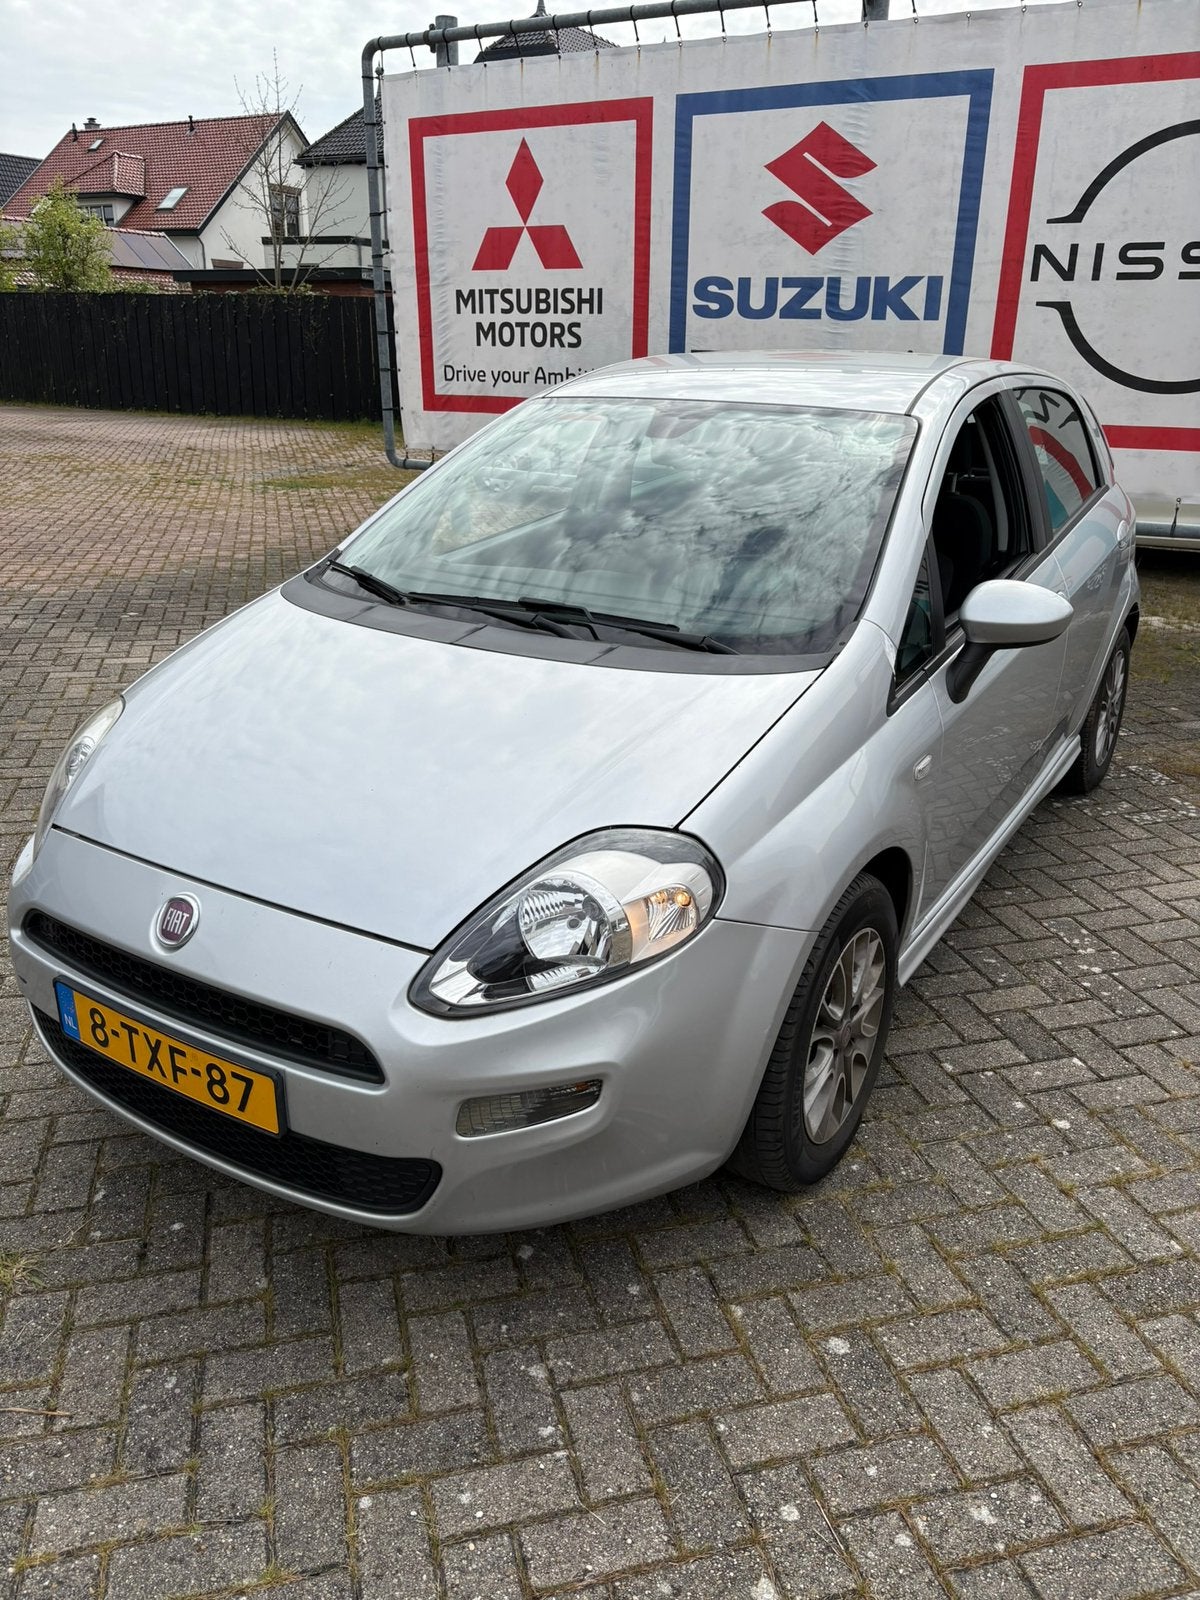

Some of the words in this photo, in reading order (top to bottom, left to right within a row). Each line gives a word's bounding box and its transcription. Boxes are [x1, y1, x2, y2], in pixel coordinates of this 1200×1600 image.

[456, 287, 602, 314] MITSUBISHI
[692, 276, 944, 320] SUZUKI
[476, 322, 582, 348] MOTORS
[444, 365, 486, 382] Drive
[491, 370, 530, 388] your
[163, 907, 190, 934] FIAT
[64, 1013, 78, 1030] NL
[89, 1007, 254, 1112] 8-TXF-87
